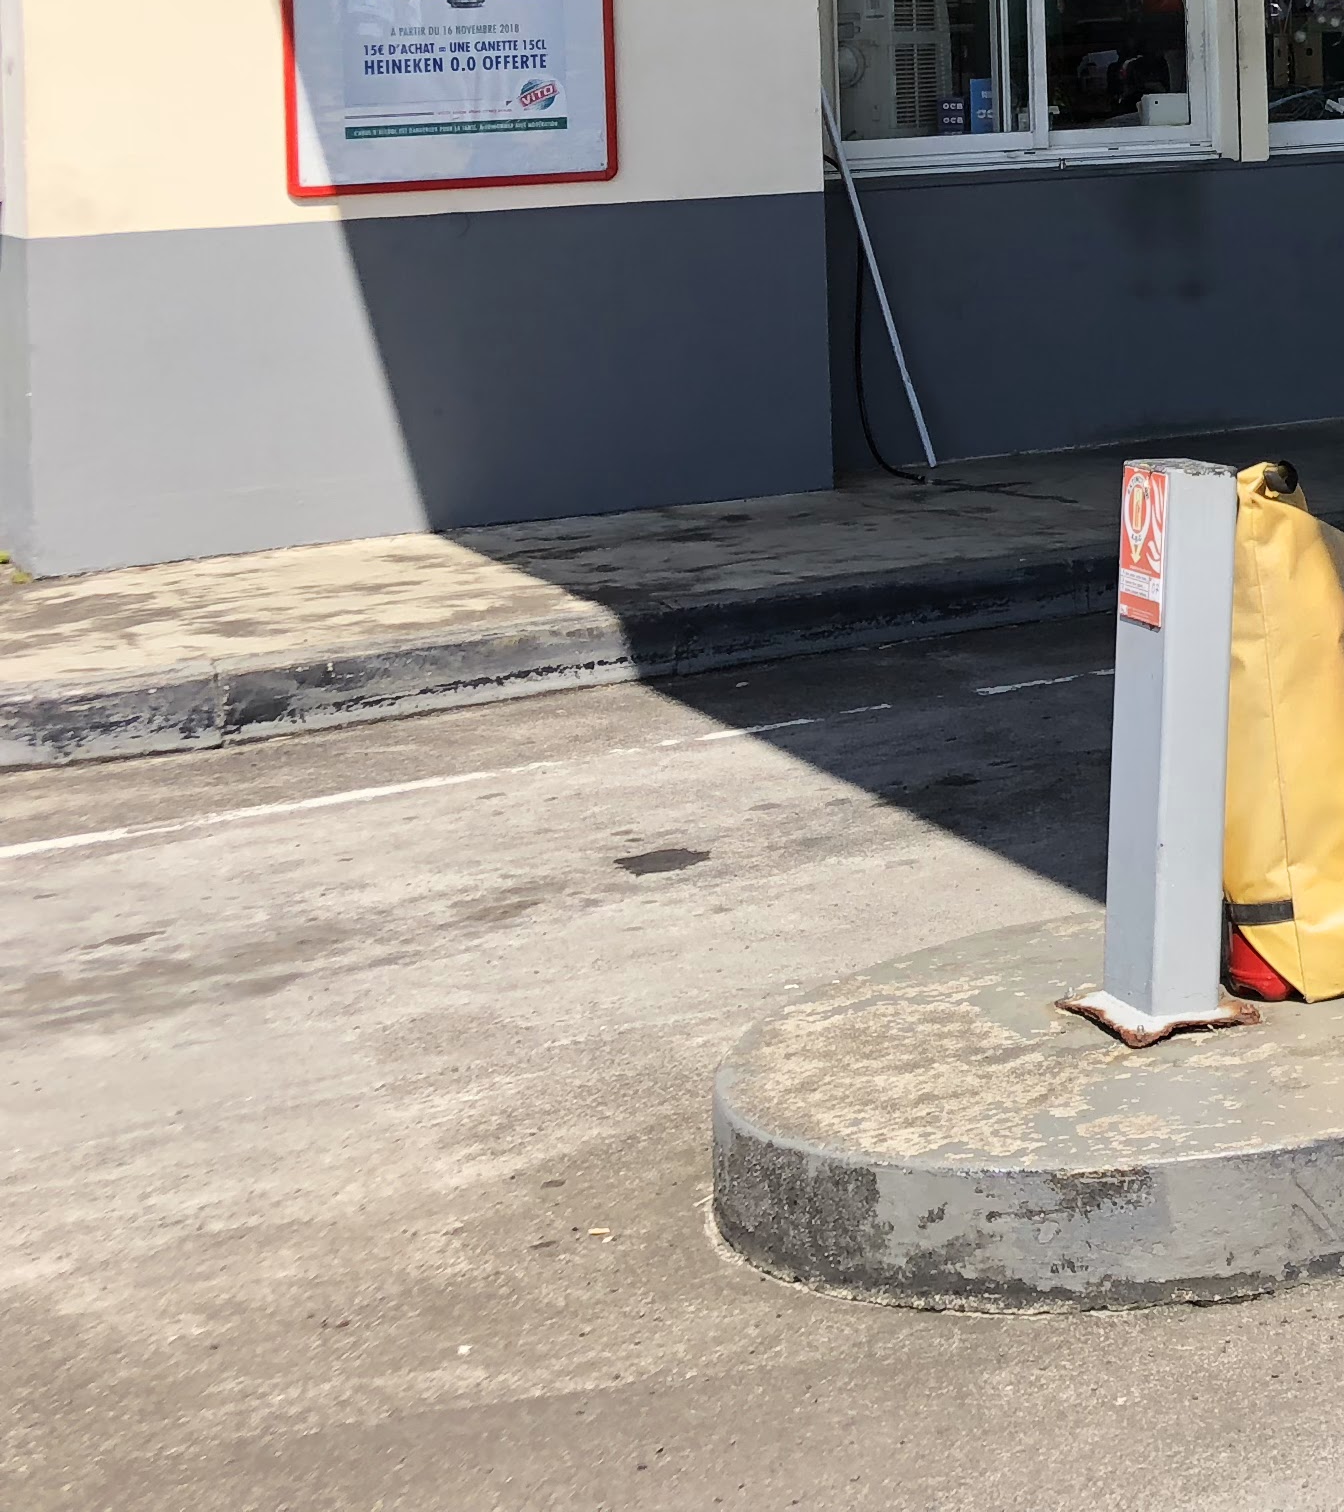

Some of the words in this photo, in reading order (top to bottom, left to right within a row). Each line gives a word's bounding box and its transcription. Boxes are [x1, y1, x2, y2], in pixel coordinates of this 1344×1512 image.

[399, 26, 426, 36] PARTIR
[428, 25, 440, 36] DU
[442, 25, 453, 36] 16
[455, 23, 497, 35] NOVEMBRE
[499, 23, 520, 34] 2018
[363, 44, 385, 56] 15€
[388, 42, 435, 55] D'ACHAT
[450, 41, 471, 53] UNE
[474, 40, 519, 53] CANETTE
[522, 39, 547, 50] 15CL
[364, 57, 444, 76] HEINEKEN
[450, 56, 477, 72] 0.0
[482, 54, 548, 71] OFFERTE
[943, 102, 963, 110] OCB
[943, 116, 963, 124] OCB
